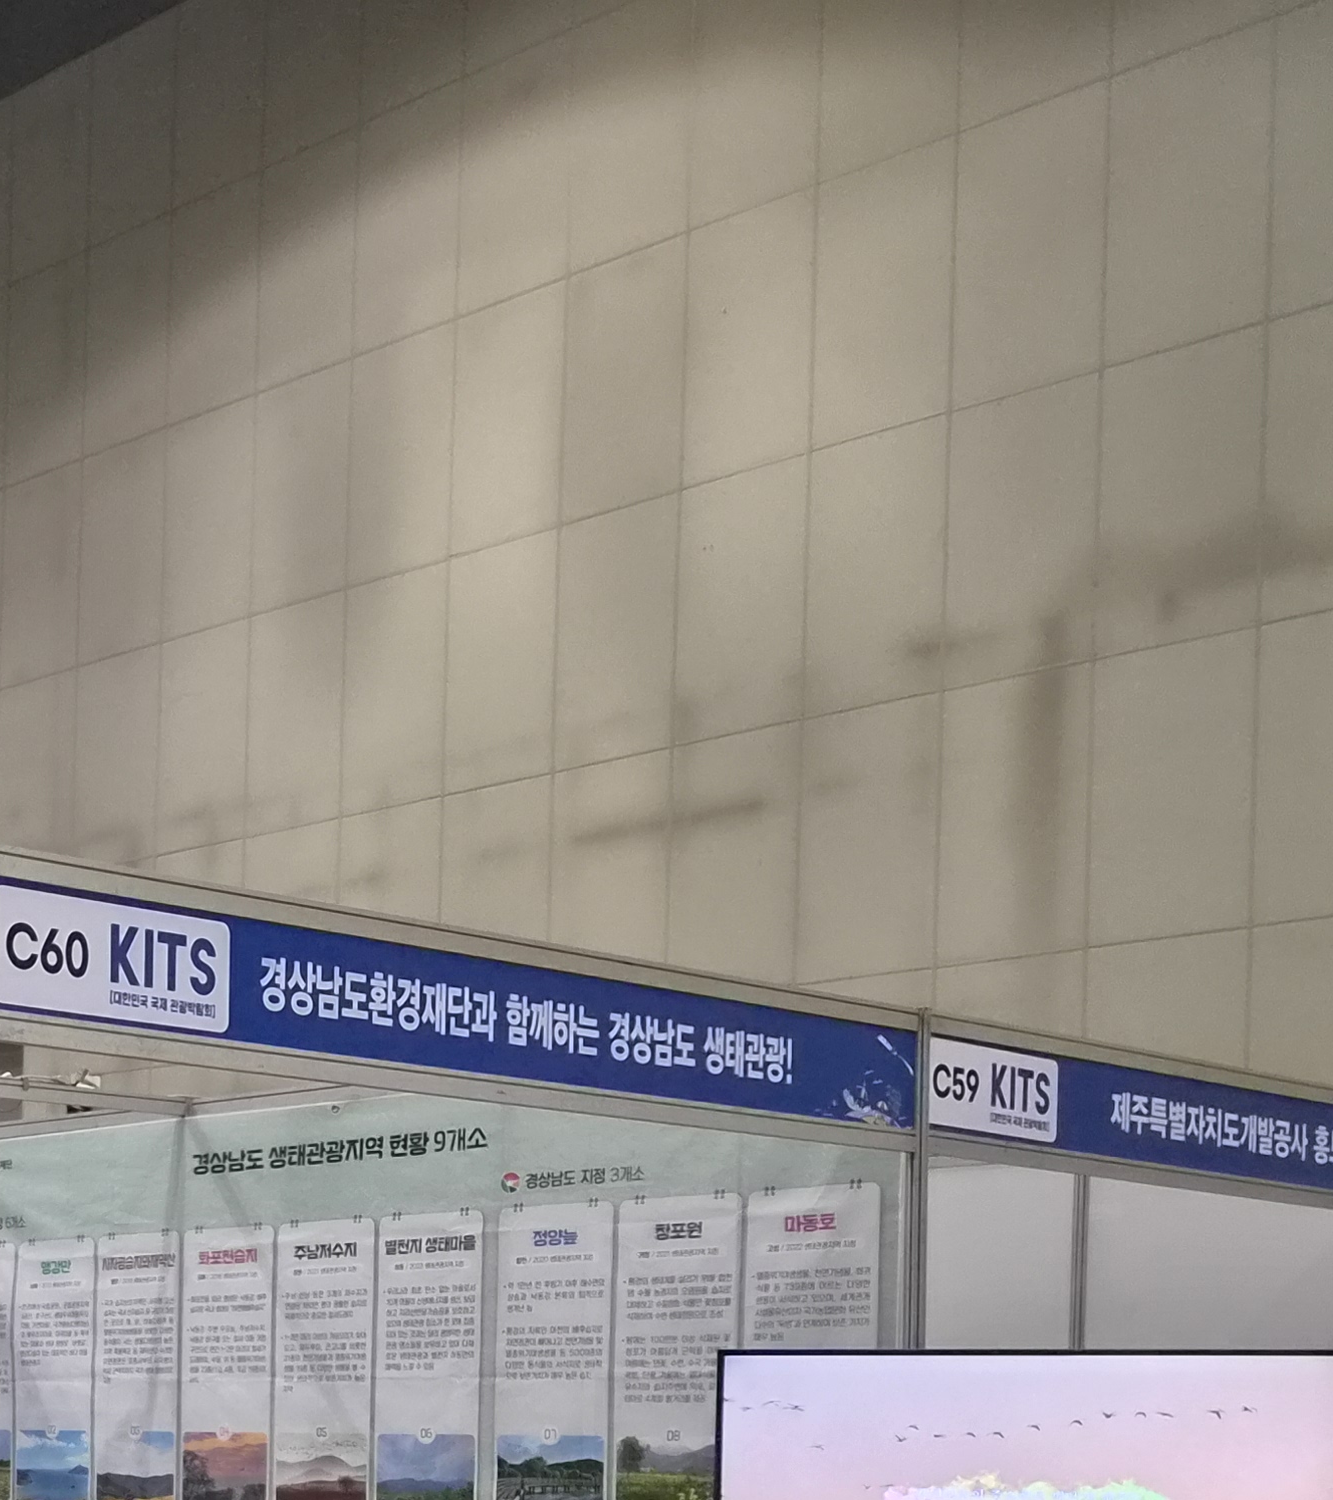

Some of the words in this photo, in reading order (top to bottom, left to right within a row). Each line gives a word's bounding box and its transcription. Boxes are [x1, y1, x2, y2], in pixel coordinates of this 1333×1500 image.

[5, 922, 89, 979] C60
[109, 923, 217, 996] KITS
[260, 956, 498, 1042] 경상남도환경재단과
[506, 993, 600, 1057] 함께하는
[608, 1011, 696, 1068] 경상남도
[703, 1026, 793, 1085] 생태관광!
[933, 1063, 980, 1103] C59
[990, 1062, 1051, 1115] KITS
[1110, 1091, 1309, 1162] 제주특별자치도개발공사
[193, 1149, 265, 1176] 경상남도
[268, 1136, 384, 1171] 생태관광지역
[389, 1133, 430, 1158] 현황
[433, 1126, 489, 1152] 9개소
[525, 1170, 577, 1190] 경상남도
[580, 1168, 606, 1186] 지정
[610, 1166, 646, 1184] 3개소
[654, 1221, 703, 1241] 창포원
[784, 1212, 837, 1233] 마동호
[425, 1234, 477, 1253] 생태마을
[532, 1229, 579, 1247] 정양늪
[293, 1241, 357, 1260] 주남저수지
[315, 1426, 328, 1439] 05
